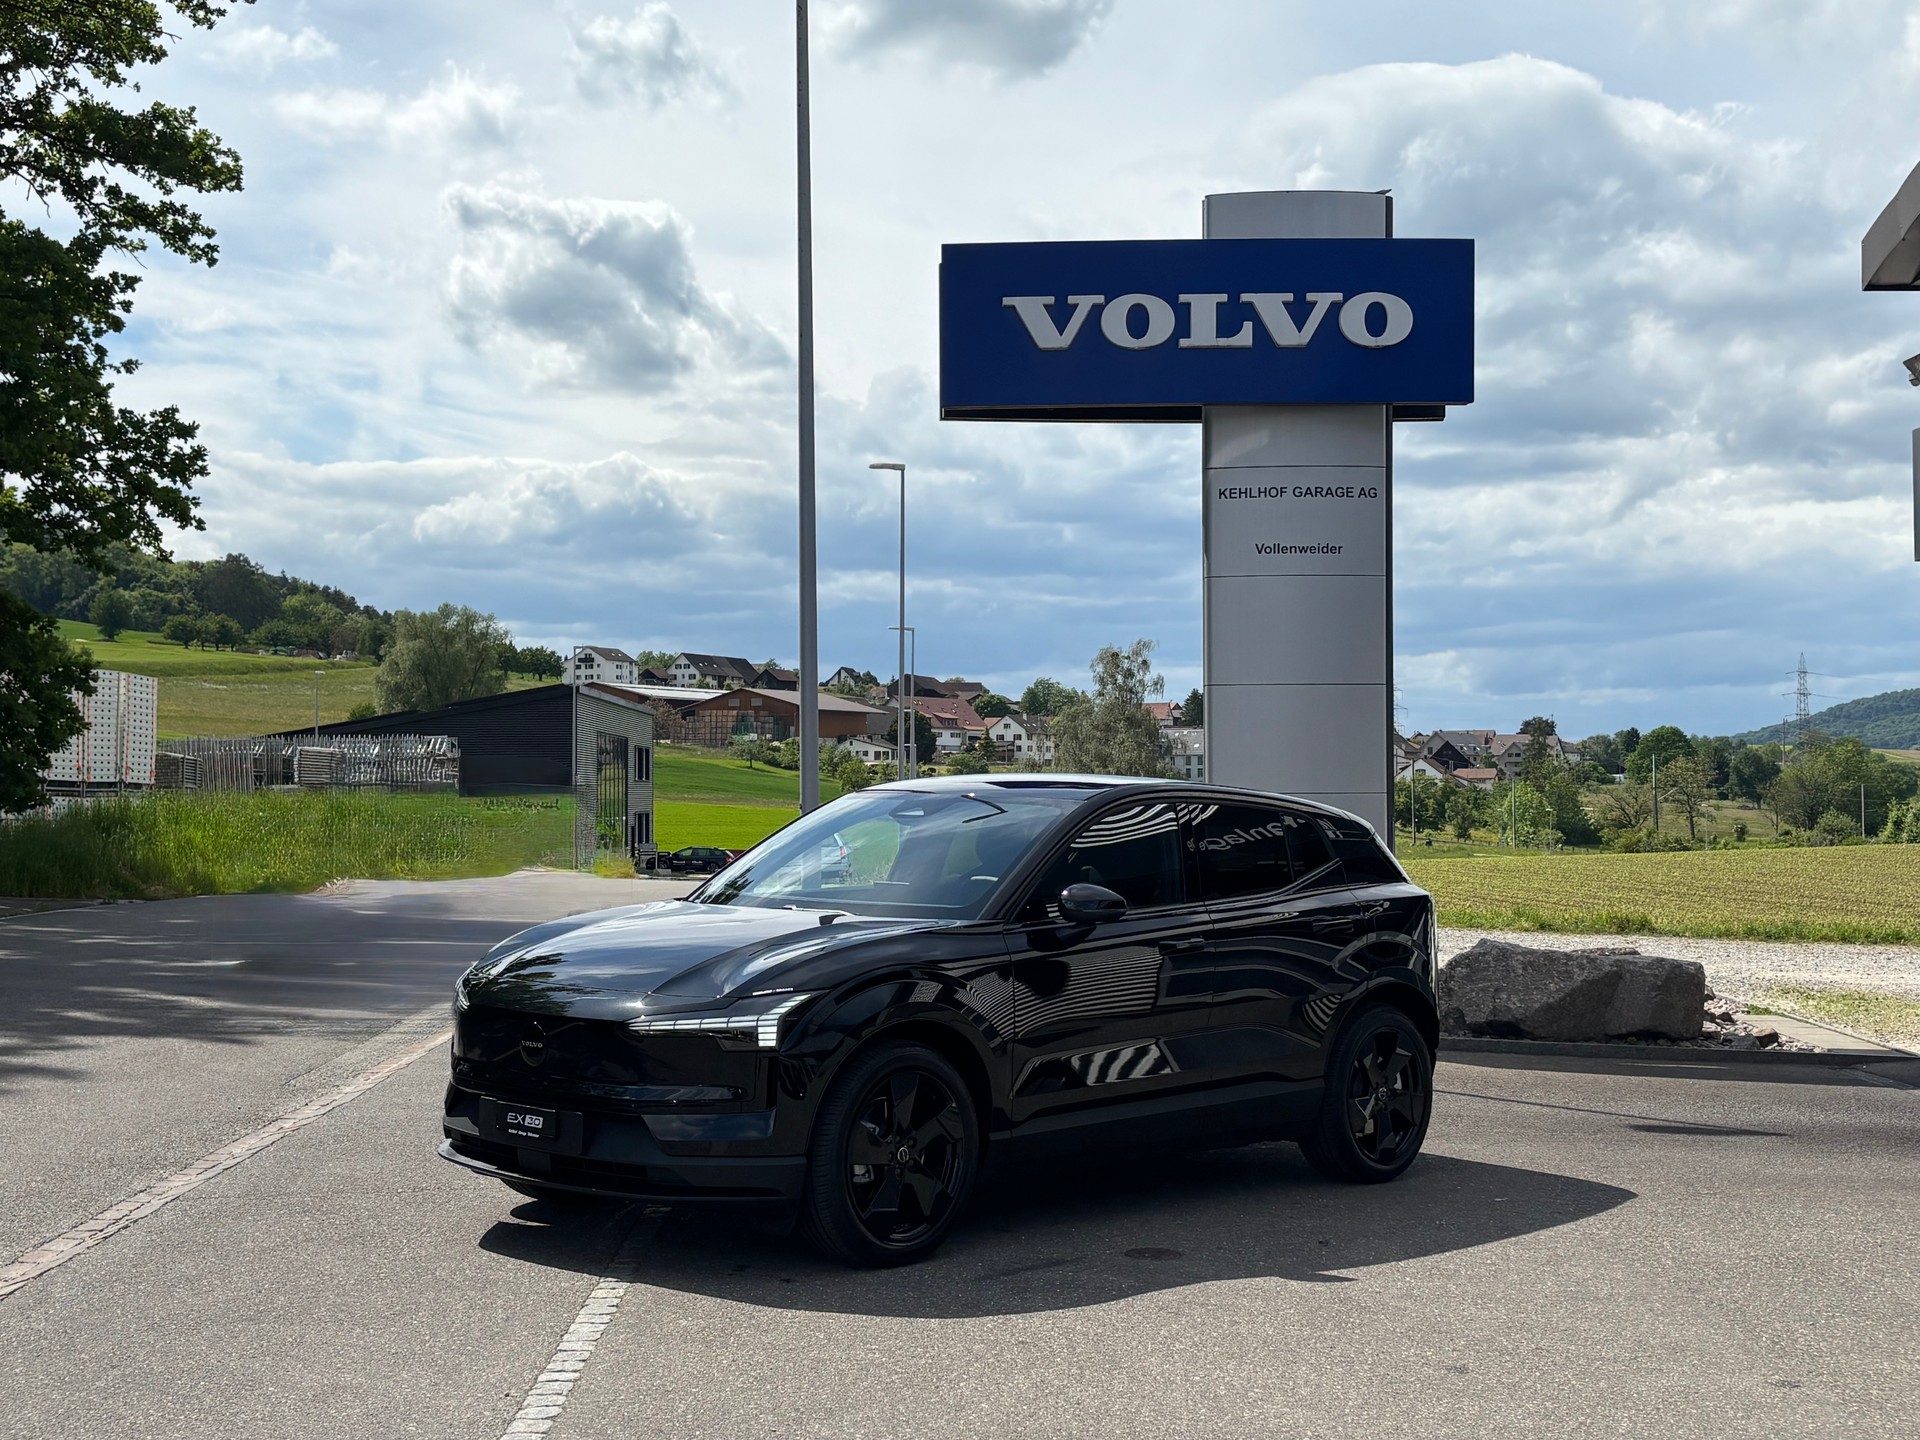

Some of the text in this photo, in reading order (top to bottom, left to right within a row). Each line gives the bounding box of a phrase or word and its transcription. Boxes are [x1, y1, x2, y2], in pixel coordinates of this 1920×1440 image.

[1002, 291, 1414, 350] VOLVO
[1218, 486, 1378, 500] KEHLHOF GARAGE AG
[1255, 543, 1344, 555] Vollenweider
[521, 1040, 543, 1048] VOLVO
